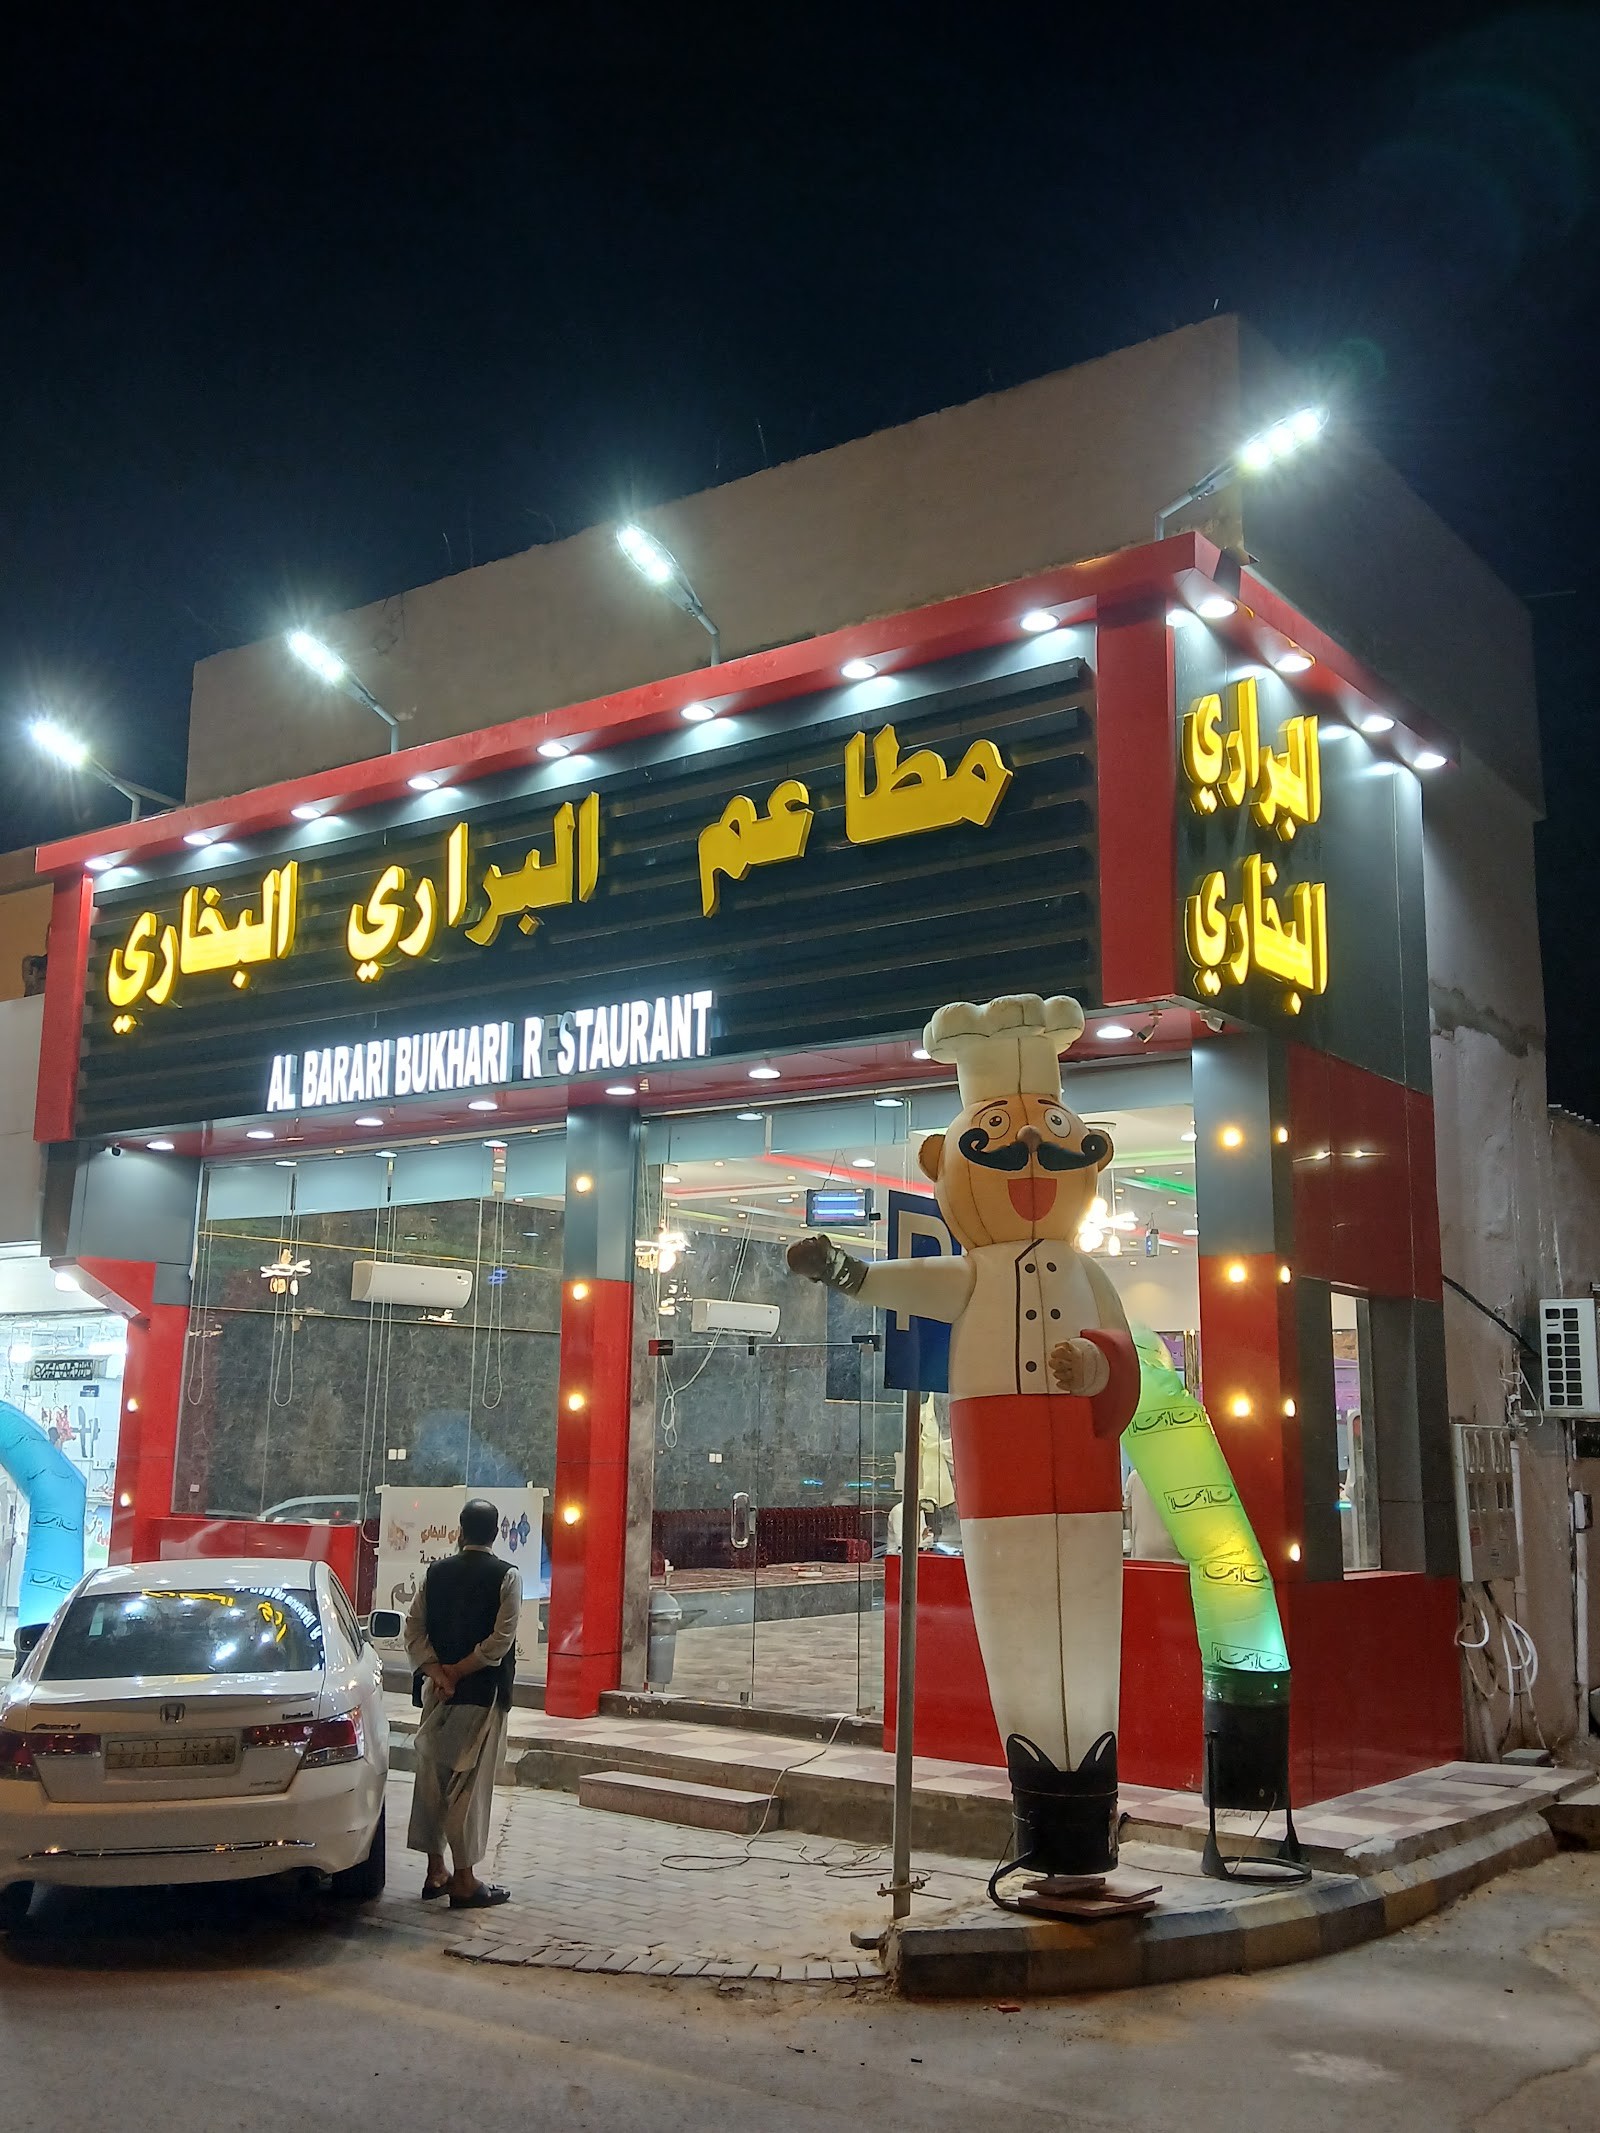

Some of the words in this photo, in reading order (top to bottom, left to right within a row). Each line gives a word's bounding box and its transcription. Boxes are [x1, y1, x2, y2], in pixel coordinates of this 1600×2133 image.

[1183, 676, 1321, 841] البراري
[107, 861, 299, 1033] البخاري
[348, 792, 600, 982] البراري
[1184, 853, 1328, 1015] البخاري
[266, 1054, 298, 1113] AL
[301, 1038, 396, 1108] BARARI
[394, 1021, 514, 1097] BUKHARI
[523, 990, 714, 1080] RESTAURANT
